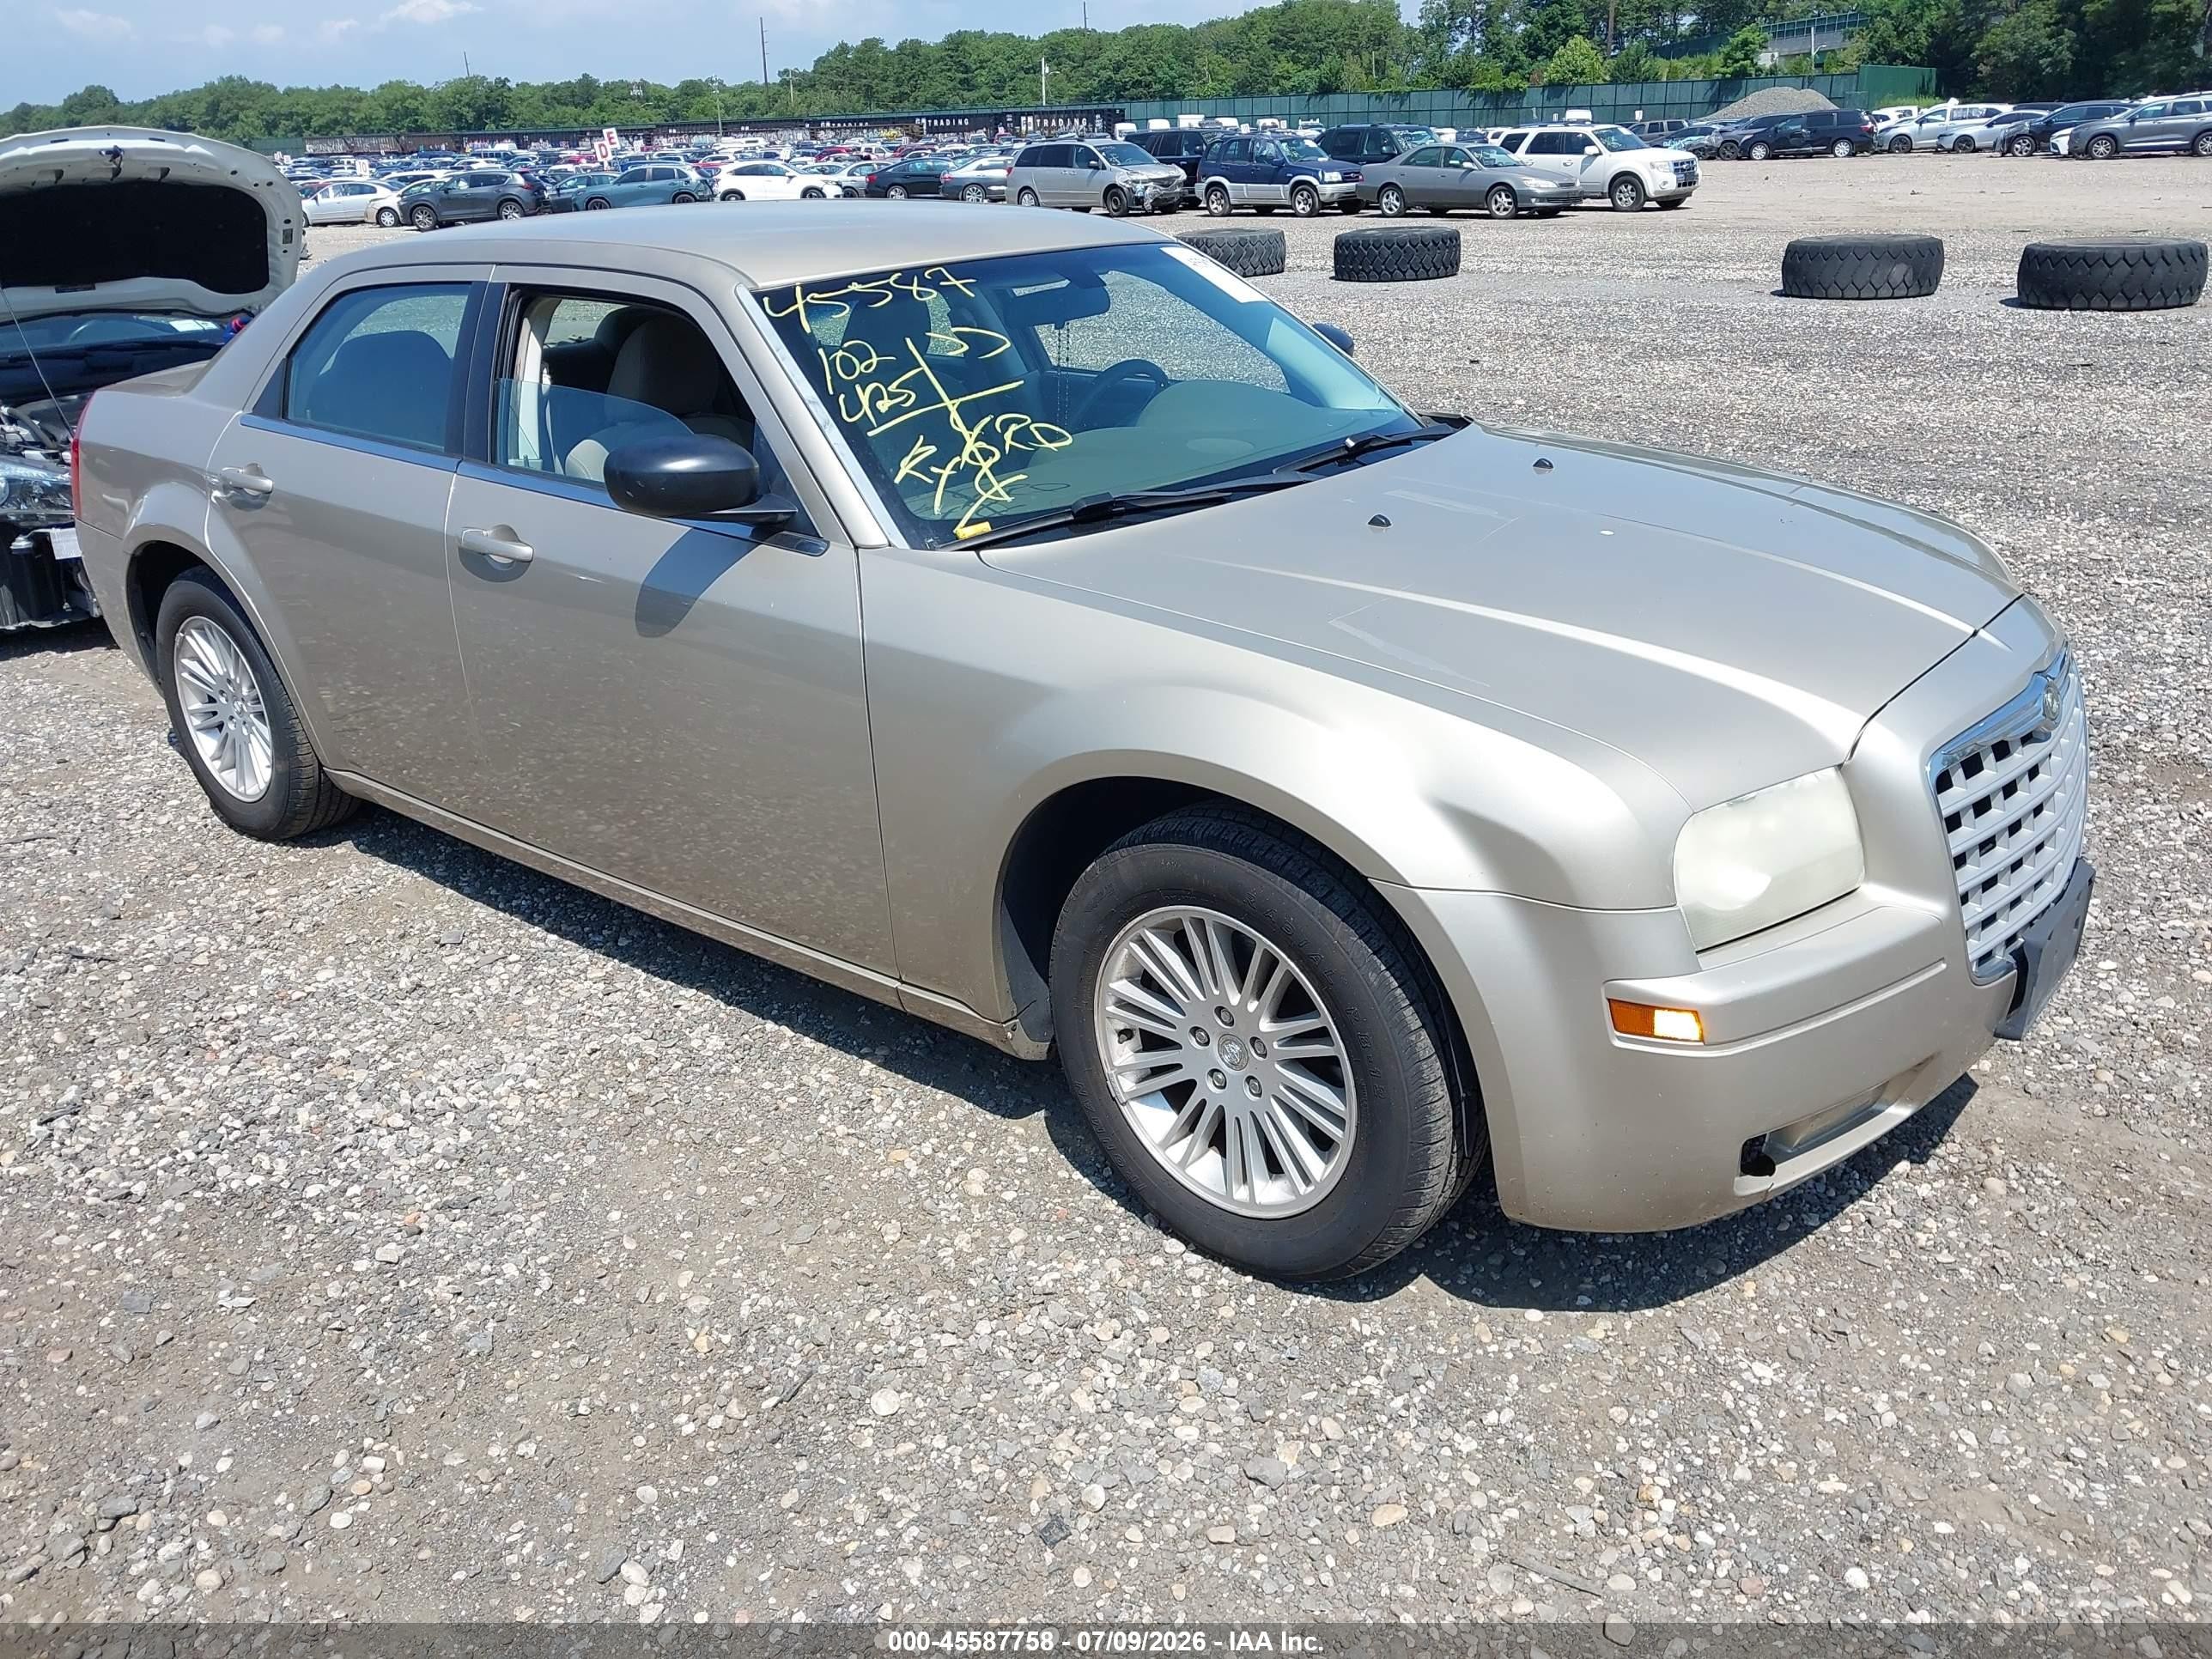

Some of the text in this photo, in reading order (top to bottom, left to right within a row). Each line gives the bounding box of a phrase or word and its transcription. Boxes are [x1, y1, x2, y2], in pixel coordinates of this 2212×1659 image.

[927, 118, 969, 127] TRADING
[1036, 117, 1087, 126] TRADING
[606, 131, 617, 145] E
[599, 143, 609, 158] D
[358, 161, 368, 173] 10
[763, 266, 976, 334] 45587
[818, 340, 896, 395] 102
[1243, 891, 1335, 985] RADIAL
